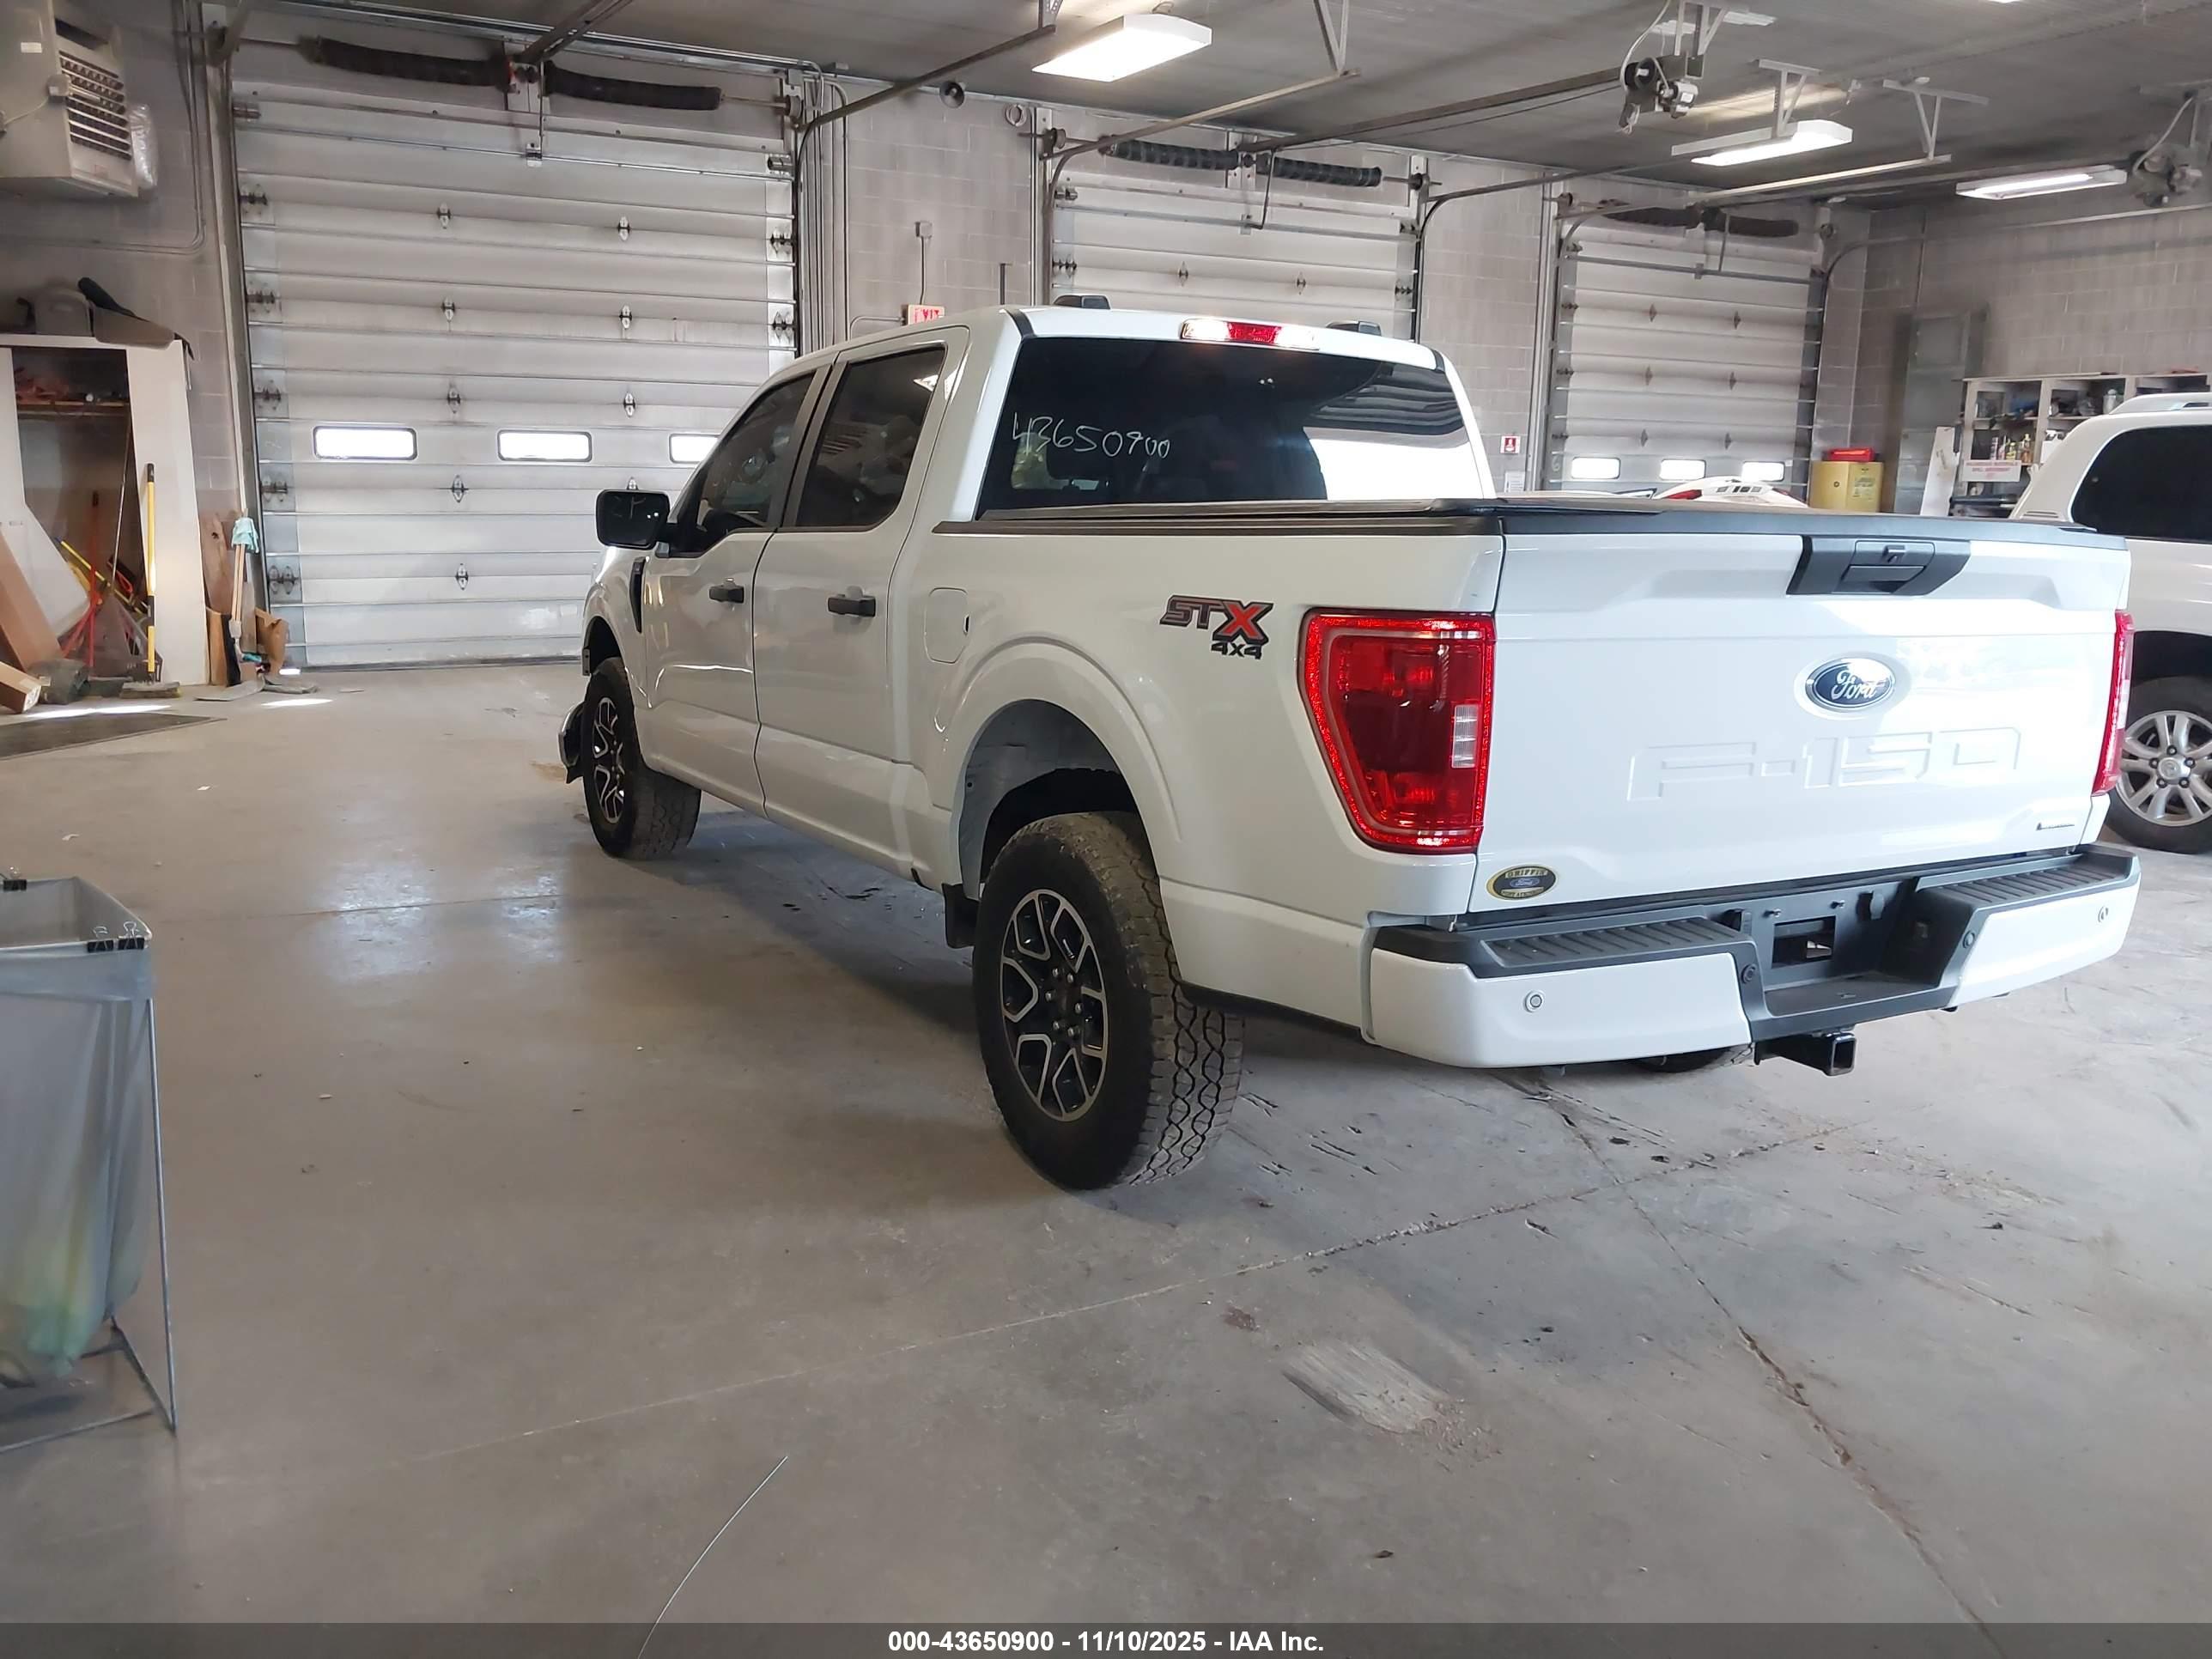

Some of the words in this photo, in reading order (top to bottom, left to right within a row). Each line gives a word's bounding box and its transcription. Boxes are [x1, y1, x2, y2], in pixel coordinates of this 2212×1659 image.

[1012, 412, 1170, 458] 43650900
[1159, 594, 1273, 646] STX
[1831, 670, 1883, 700] Ford
[1627, 727, 2022, 801] F-150
